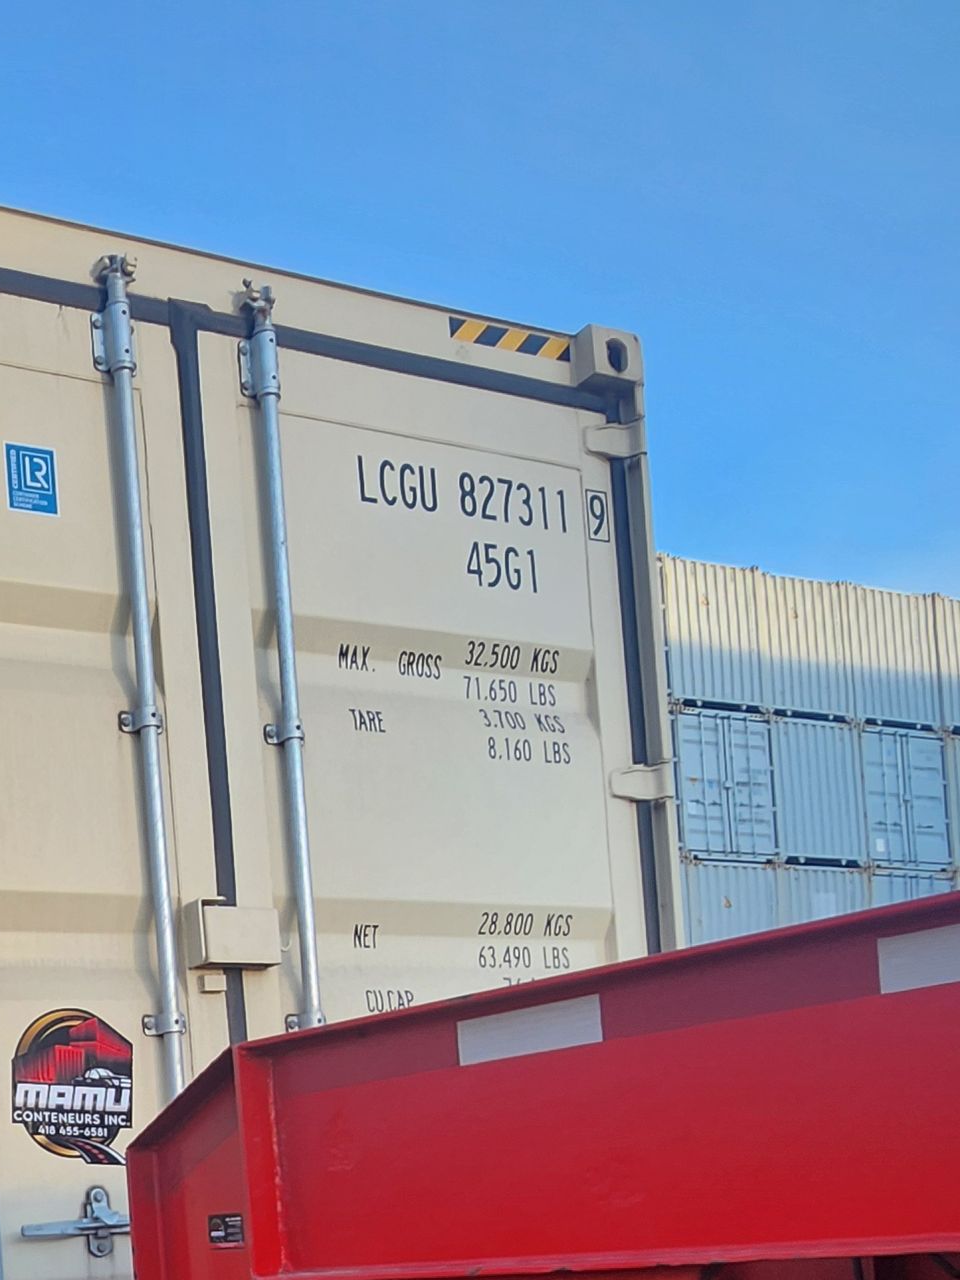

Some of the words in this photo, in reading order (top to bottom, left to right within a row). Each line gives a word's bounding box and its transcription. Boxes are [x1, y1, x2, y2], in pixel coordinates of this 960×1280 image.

[25, 456, 49, 489] LR
[357, 455, 438, 512] LCGU
[458, 471, 567, 533] 827311
[589, 494, 606, 536] 9
[466, 541, 538, 593] 45G1
[338, 643, 376, 673] MAX.
[398, 650, 442, 680] GROSS
[530, 647, 560, 675] KGS
[529, 682, 557, 707] LBS
[348, 708, 387, 734] TARE
[478, 708, 526, 731] 3.700
[535, 712, 566, 734] KGS
[488, 736, 532, 763] 8.160
[543, 740, 572, 765] LBS
[353, 924, 380, 949] NET
[543, 913, 574, 938] KGS
[478, 945, 532, 970] 63.490
[542, 946, 571, 970] LBS
[13, 1110, 101, 1125] CONTENEURS
[104, 1114, 131, 1127] INC.
[38, 1124, 56, 1136] 418
[59, 1125, 108, 1138] 455-6581
